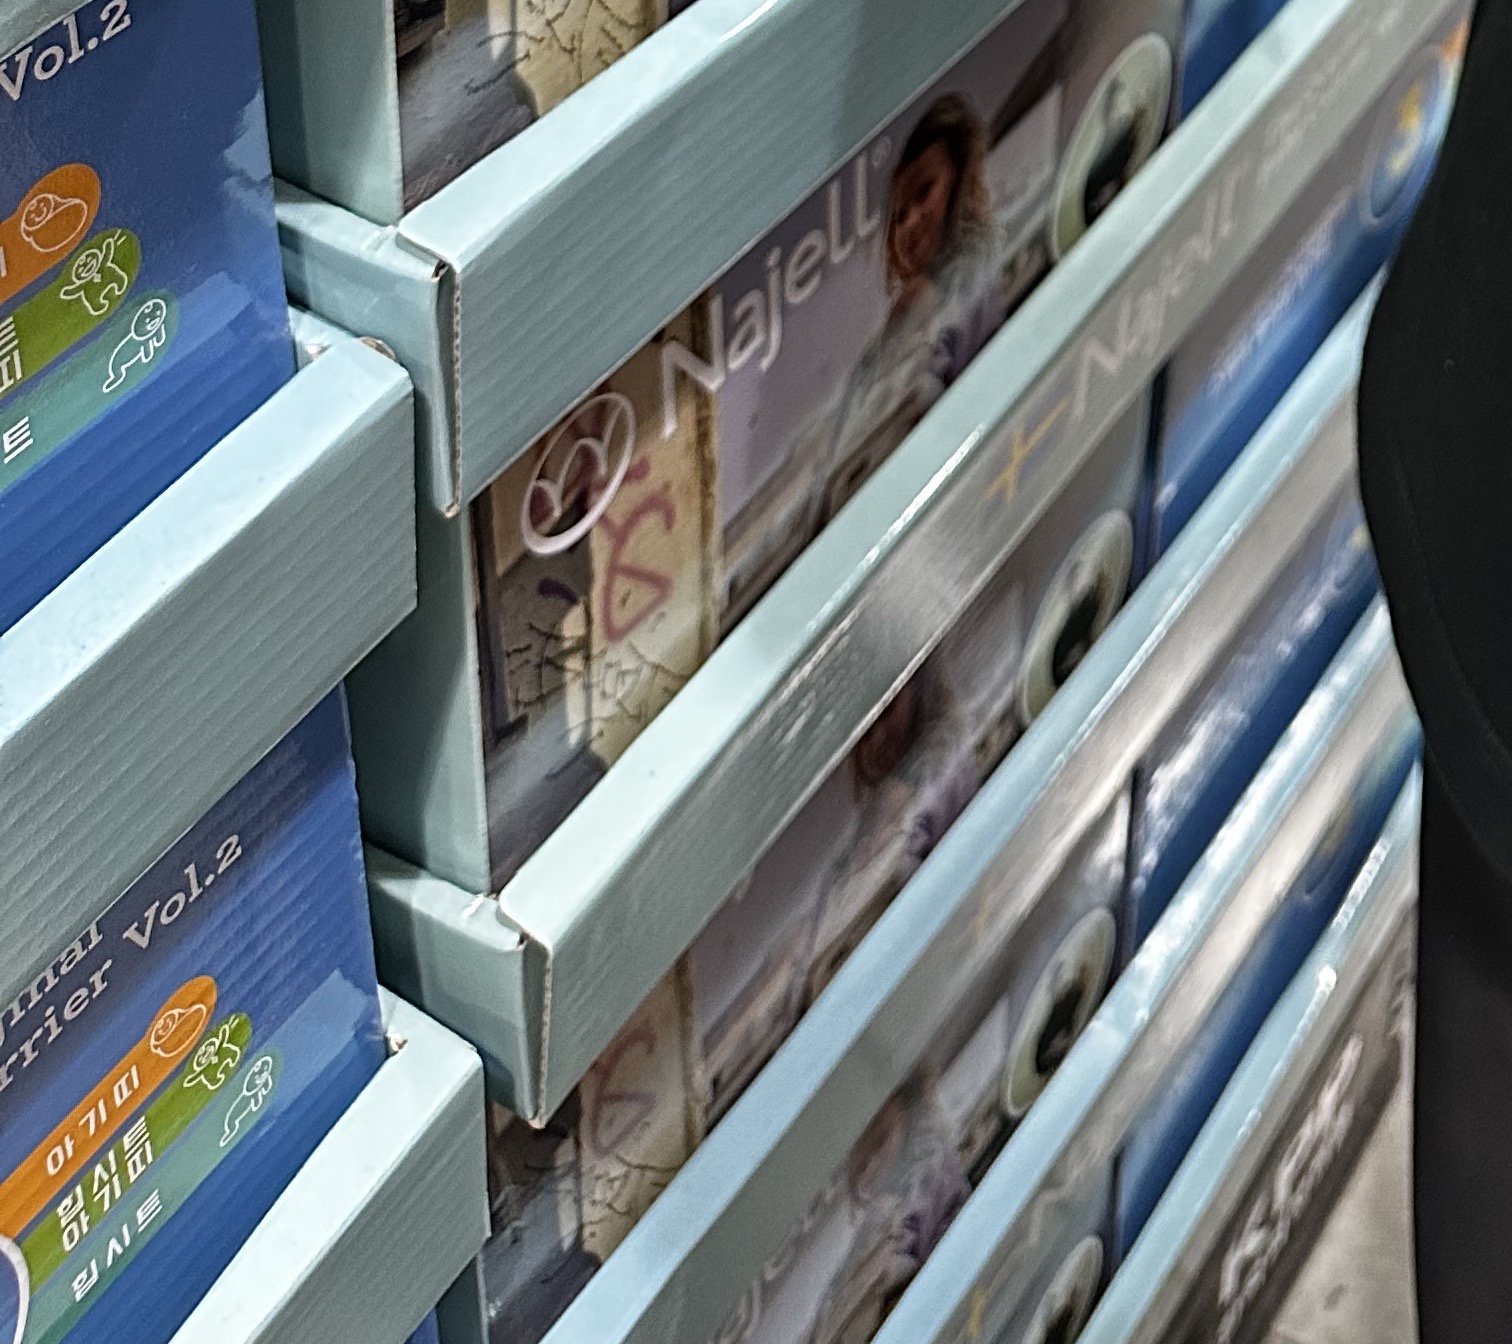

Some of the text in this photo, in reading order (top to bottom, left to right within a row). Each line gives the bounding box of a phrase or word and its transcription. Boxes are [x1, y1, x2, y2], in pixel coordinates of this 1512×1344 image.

[122, 833, 243, 949] Vol.2
[0, 918, 103, 1048] inal
[71, 1187, 163, 1303] 힙시트
